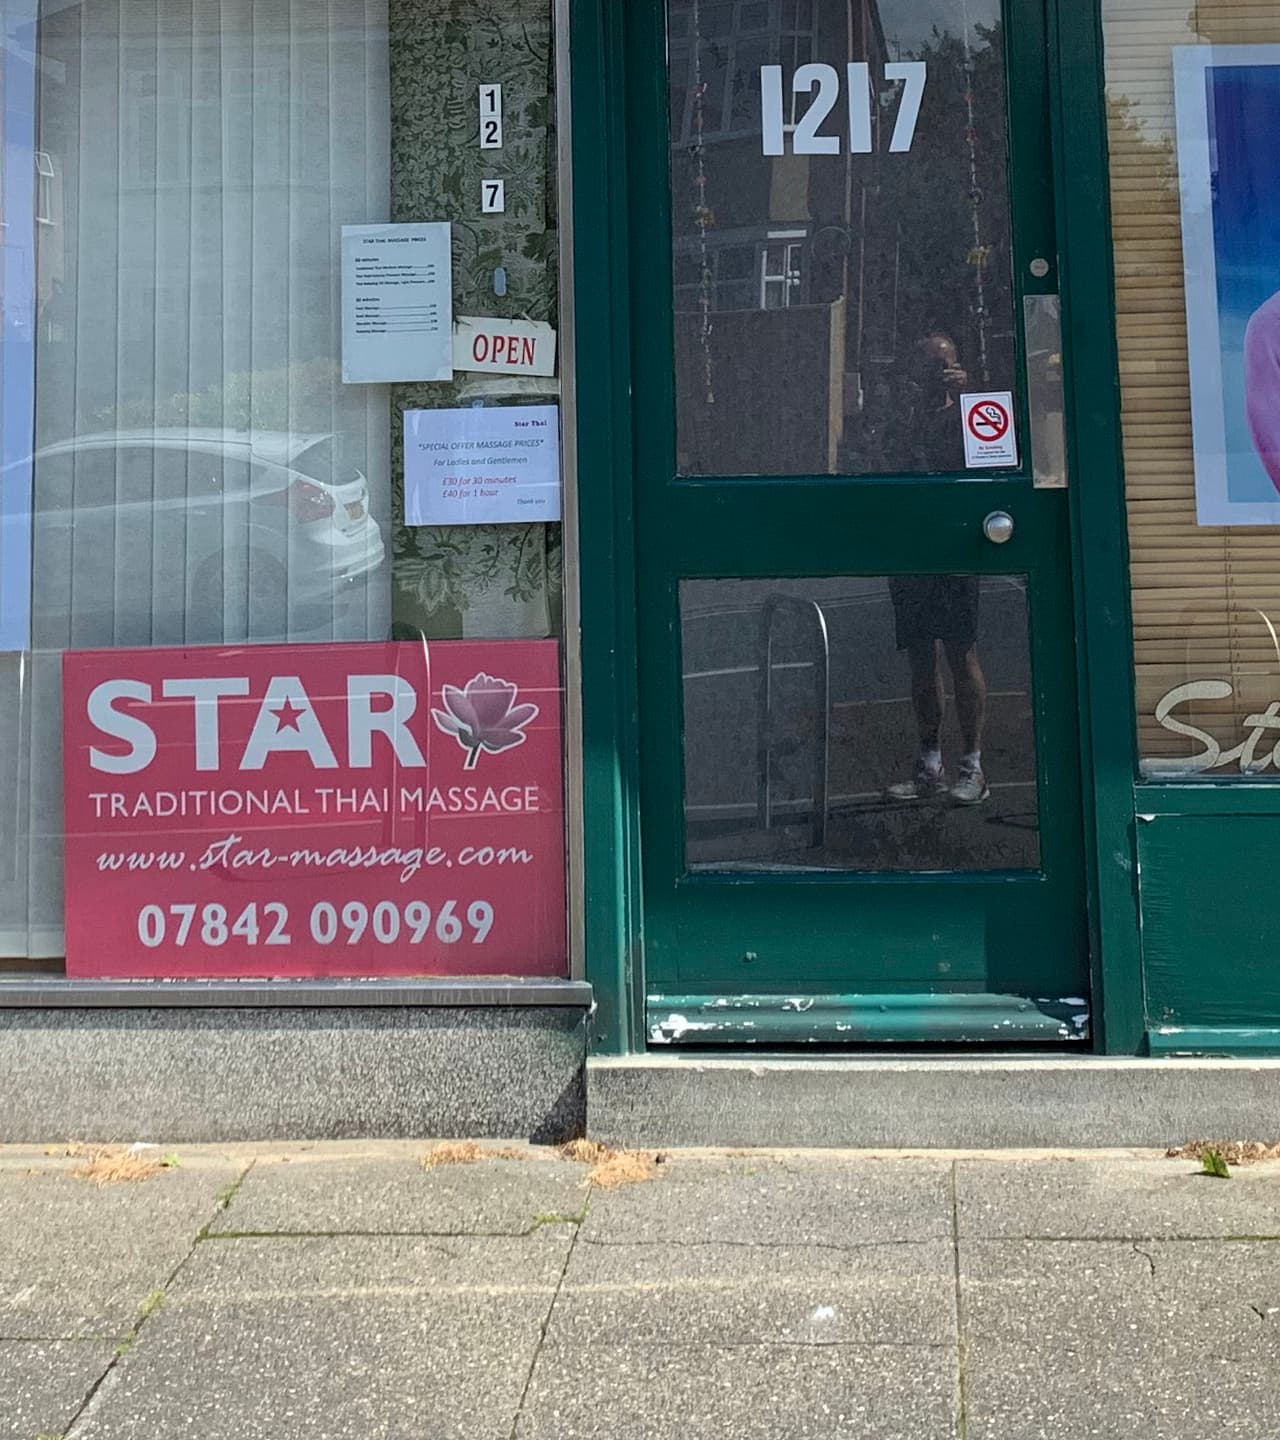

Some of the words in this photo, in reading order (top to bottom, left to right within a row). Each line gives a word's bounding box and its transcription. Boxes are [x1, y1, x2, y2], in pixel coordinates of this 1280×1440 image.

[760, 61, 927, 156] 1217
[473, 333, 537, 366] OPEN
[476, 440, 513, 450] MASSAGE
[87, 675, 427, 774] STAR
[88, 789, 310, 817] TRADITIONAL
[315, 788, 389, 814] THAI
[400, 786, 540, 813] MASSAGE
[96, 833, 534, 883] www.star-massage.com
[137, 902, 292, 948] 07842
[310, 900, 495, 945] 090969
